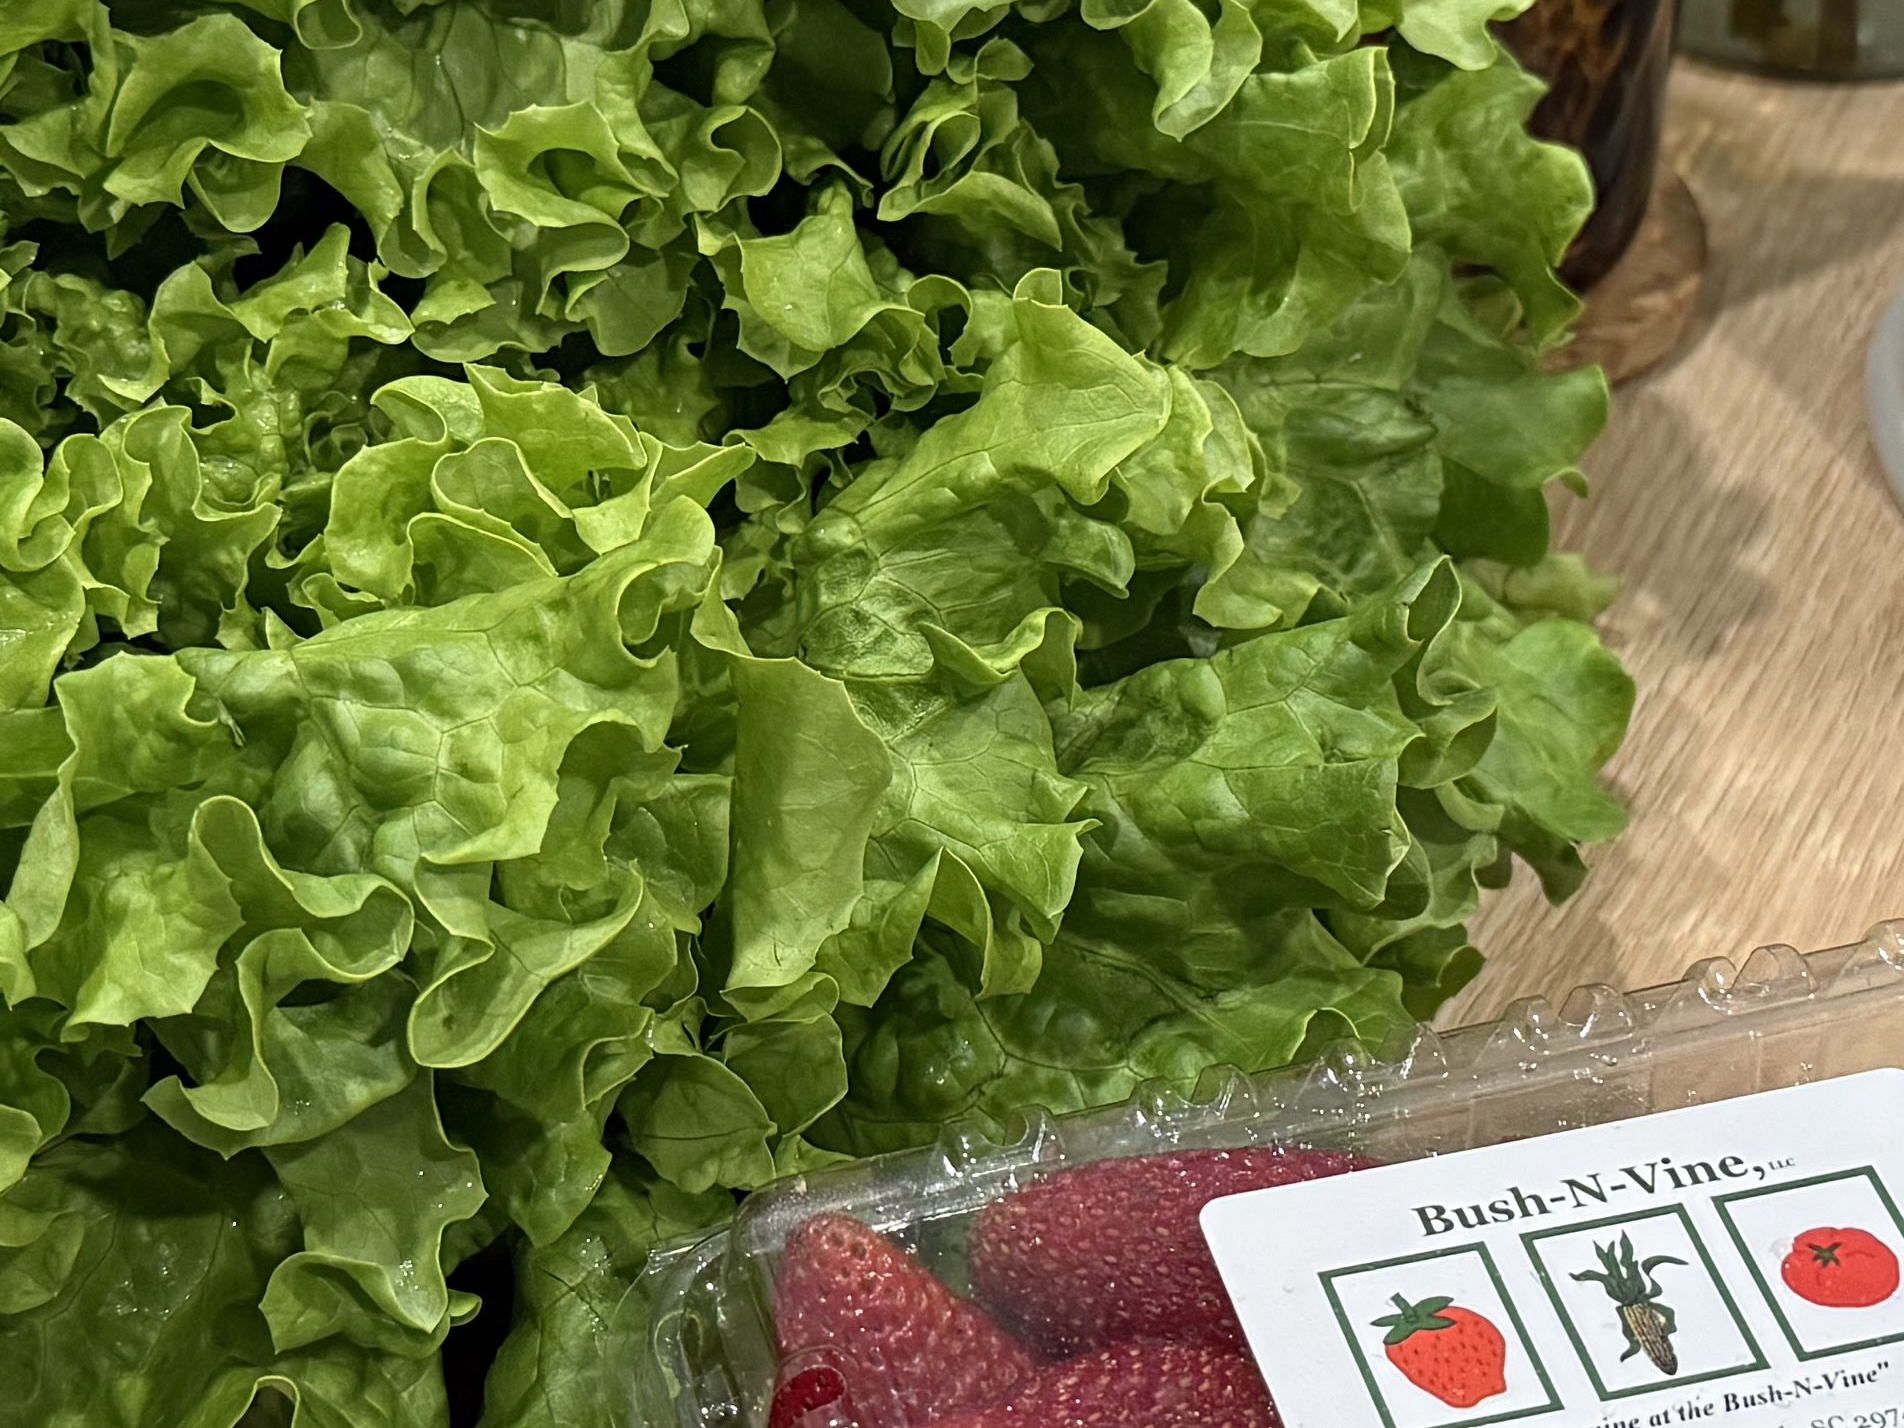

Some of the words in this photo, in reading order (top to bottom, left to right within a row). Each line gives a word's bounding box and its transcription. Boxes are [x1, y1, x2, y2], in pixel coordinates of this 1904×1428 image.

[1410, 1155, 1766, 1237] Bush-N-Vine,
[1649, 1409, 1672, 1427] at
[1677, 1400, 1714, 1422] the
[1724, 1361, 1890, 1413] Bush-N-Vine"
